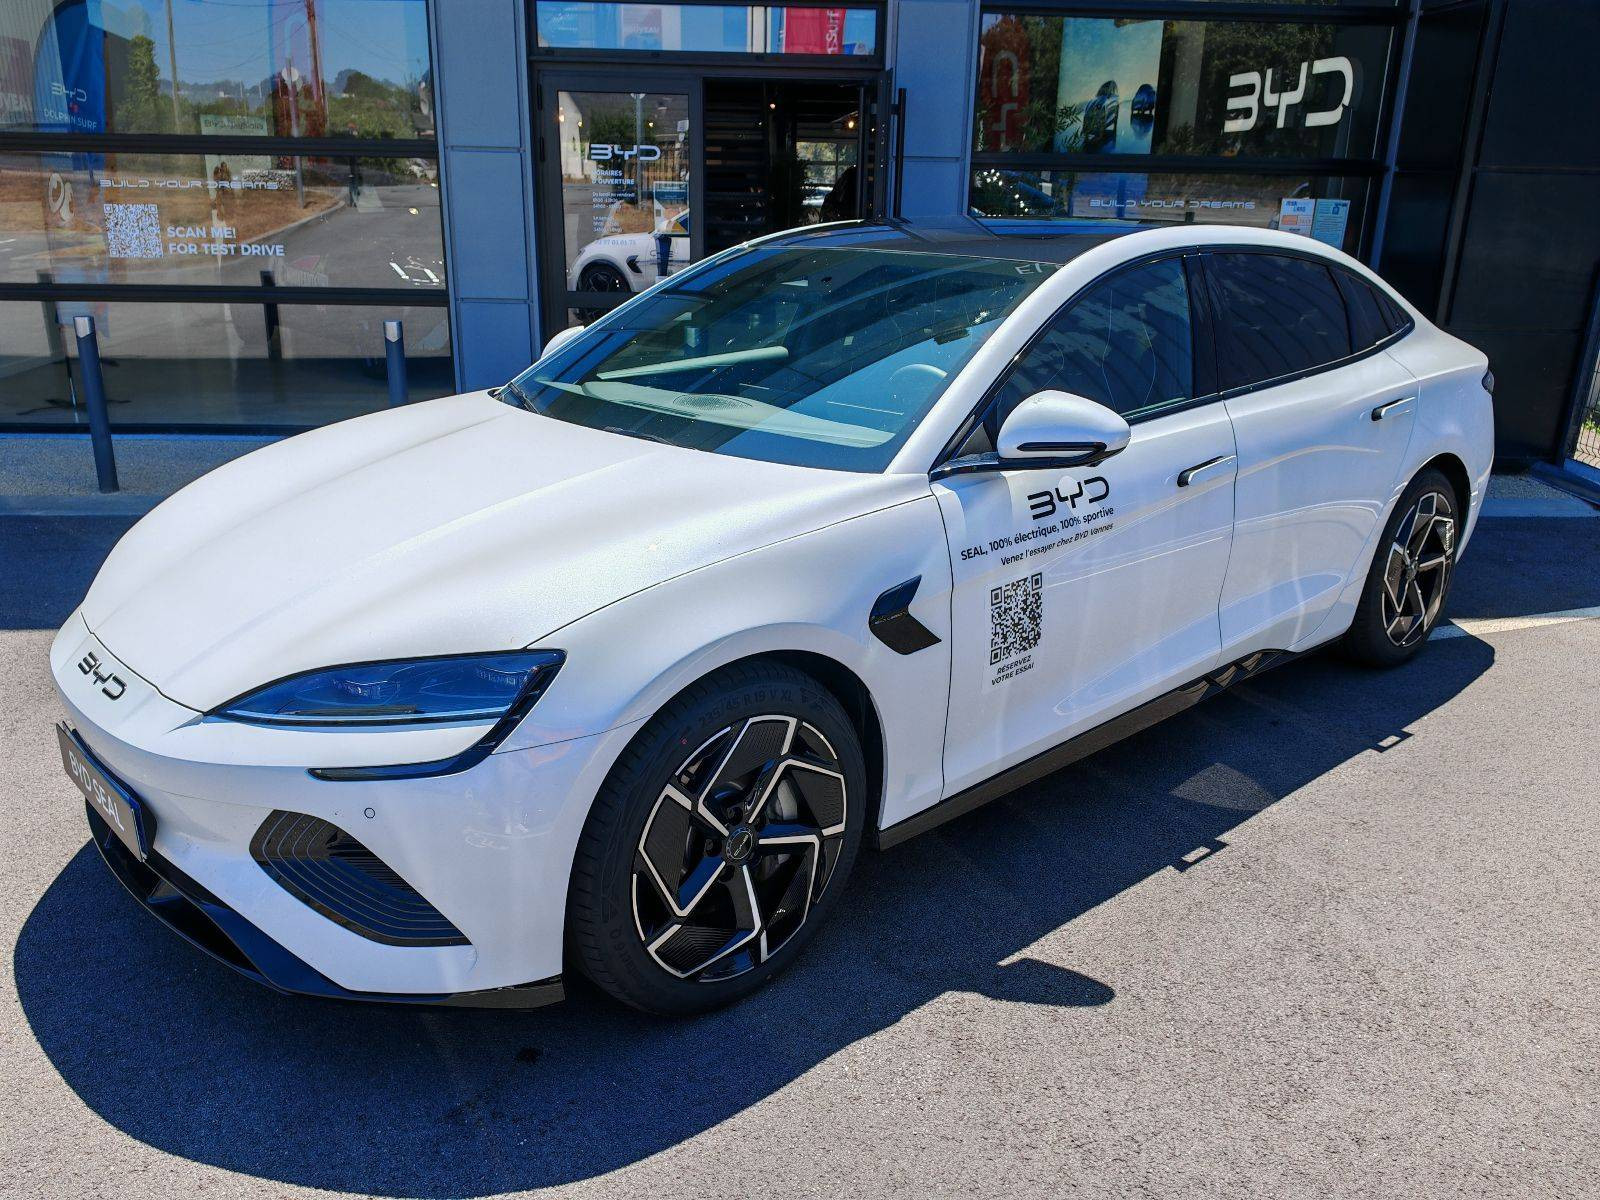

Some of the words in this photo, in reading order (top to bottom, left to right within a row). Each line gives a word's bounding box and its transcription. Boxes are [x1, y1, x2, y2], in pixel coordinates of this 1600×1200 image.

[49, 81, 88, 102] BYD
[1223, 56, 1354, 133] BYD
[43, 108, 76, 124] DOLPHIN
[77, 117, 98, 130] SURF
[590, 143, 662, 161] BYD
[99, 179, 150, 189] BUILD
[154, 179, 203, 189] YOUR
[206, 179, 280, 190] DREAMS
[1089, 199, 1137, 208] BUILD
[1140, 199, 1185, 209] YOUR
[1188, 200, 1257, 210] DREAMS
[167, 226, 207, 239] SCAN
[210, 226, 237, 239] ME!
[168, 243, 199, 255] FOR
[203, 243, 236, 256] TEST
[241, 244, 286, 257] DRIVE
[1027, 476, 1110, 521] BYD
[960, 545, 988, 561] SEAL,
[988, 537, 1013, 552] 100%
[1013, 526, 1060, 545] électrique,
[1059, 516, 1082, 530] 100%
[1082, 507, 1115, 526] sportive
[1000, 554, 1024, 566] Venez
[1025, 542, 1056, 559] l'essayer
[1056, 536, 1074, 548] chez
[1074, 529, 1089, 542] BYD
[77, 651, 127, 701] BYD
[991, 670, 1015, 686] VOTRE
[1015, 662, 1035, 676] ESSAI
[68, 749, 92, 793] BYD
[92, 777, 125, 832] SEAL
